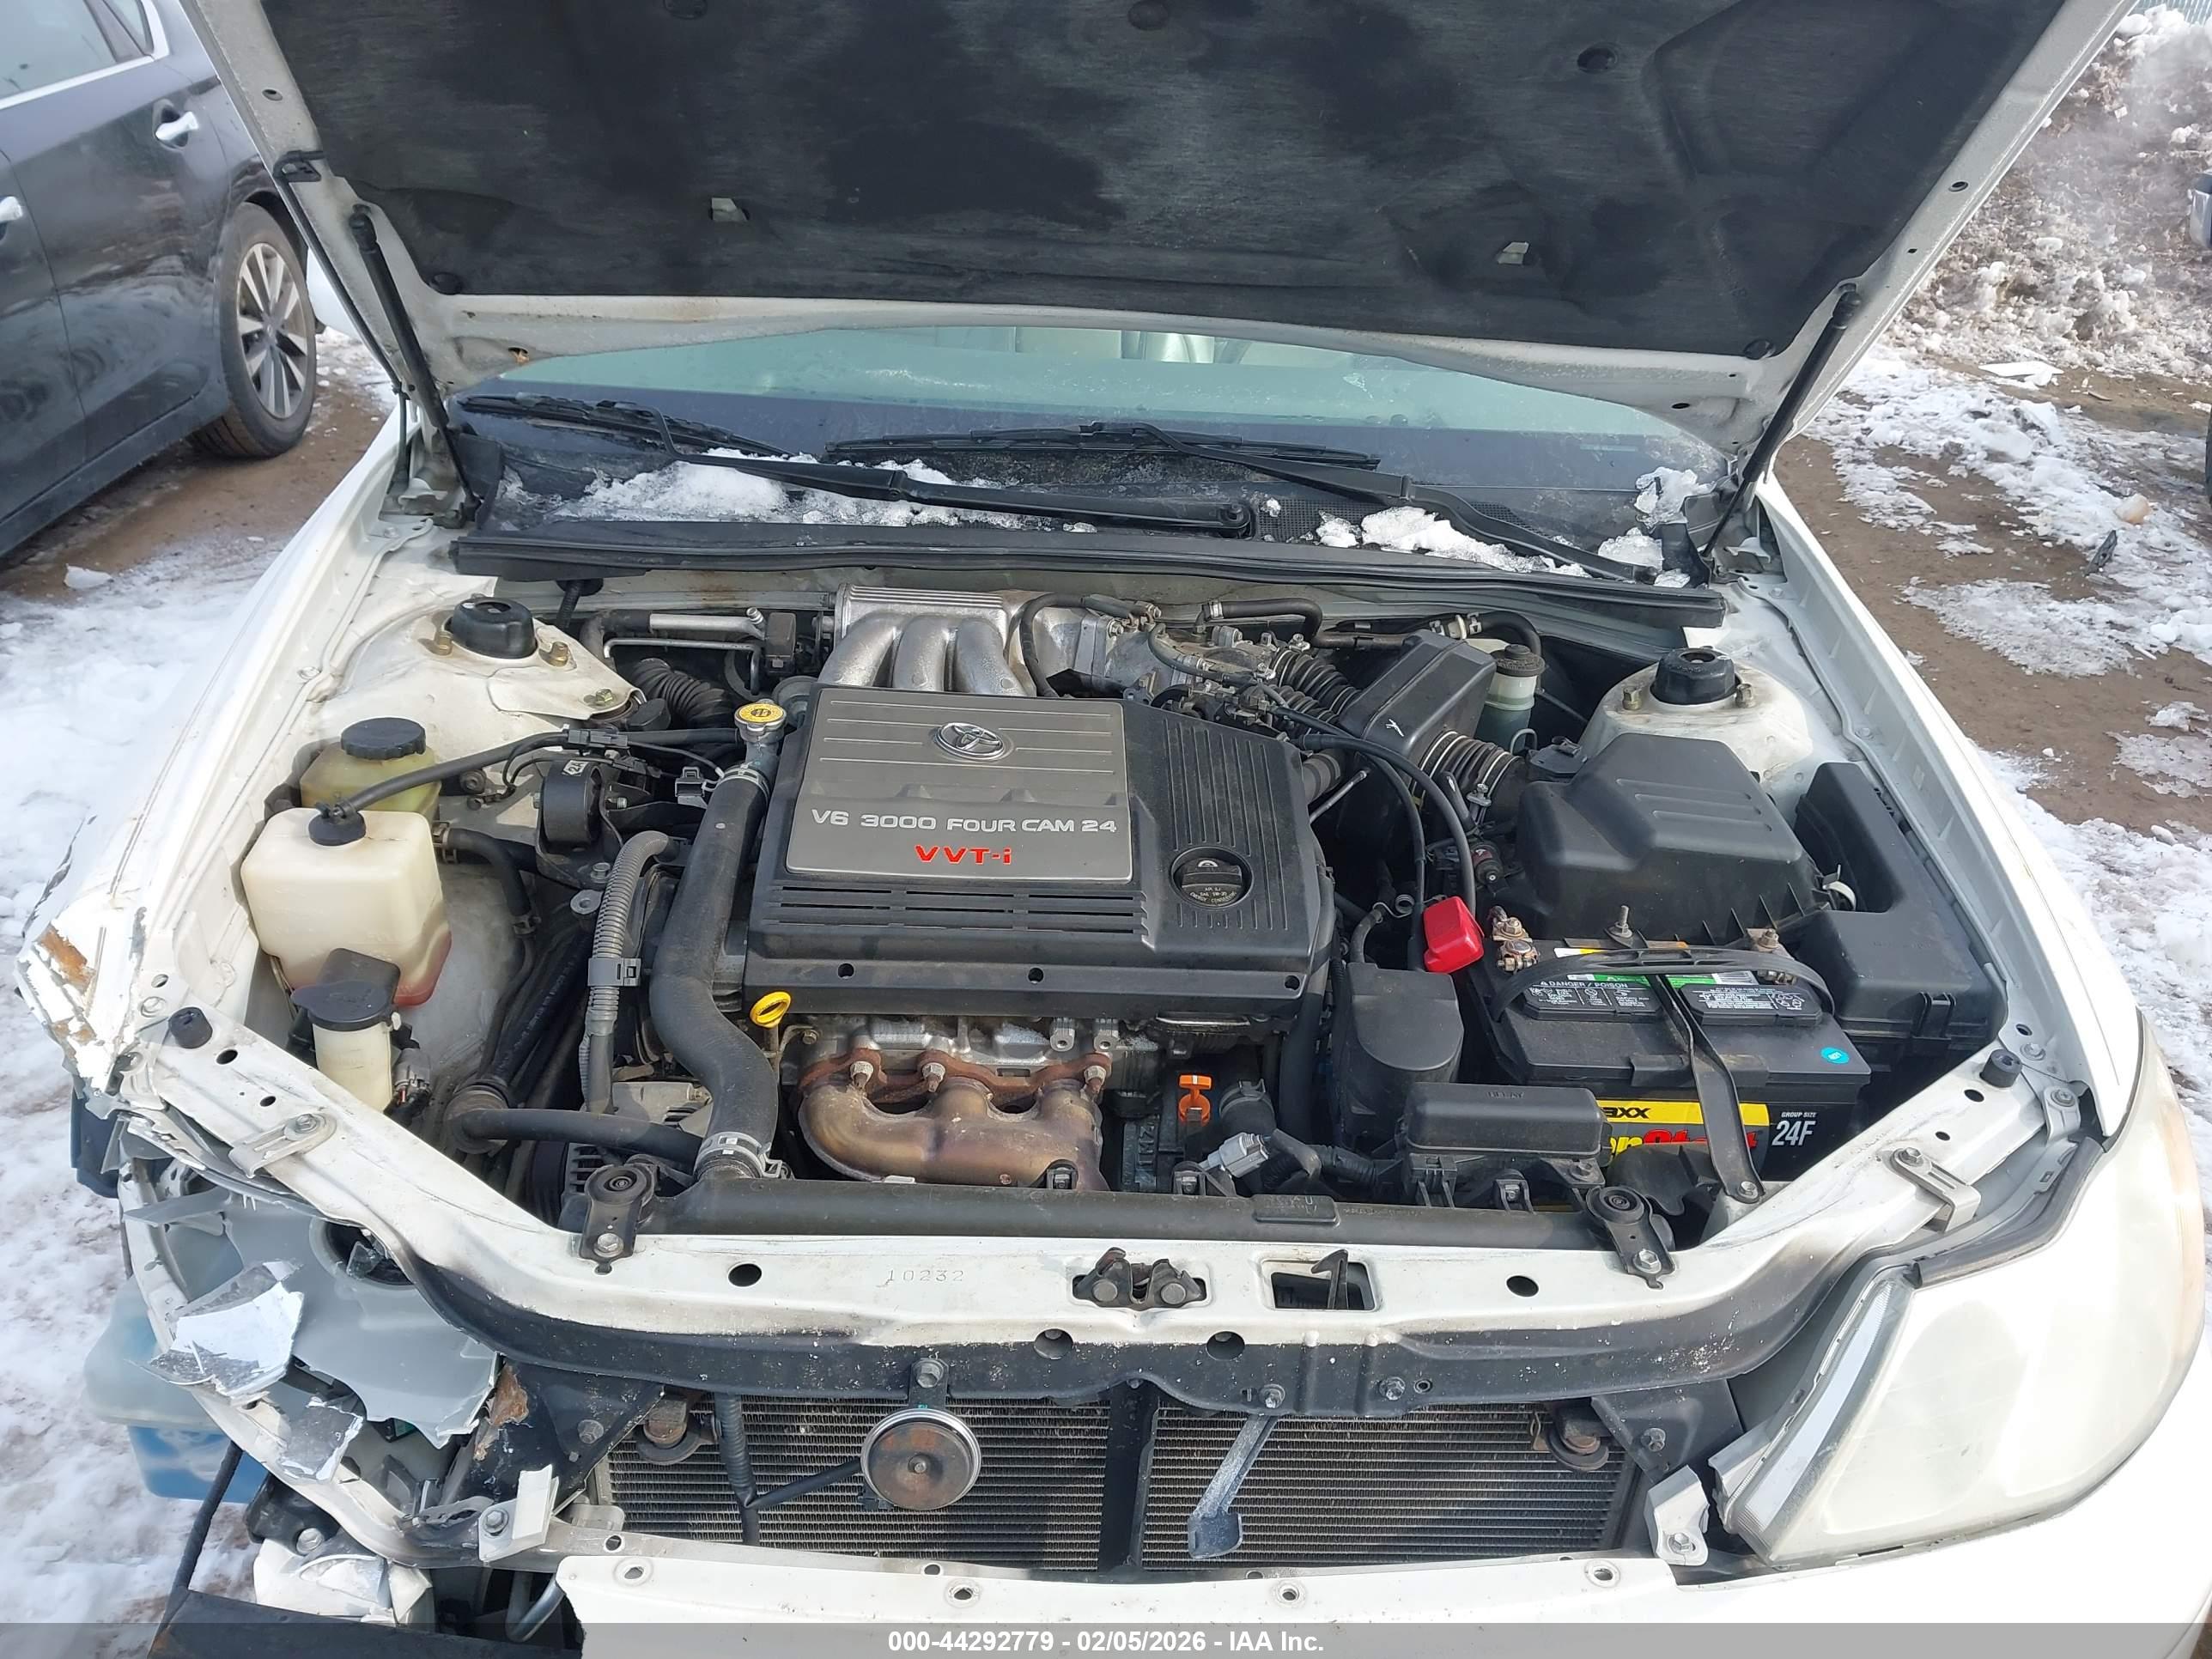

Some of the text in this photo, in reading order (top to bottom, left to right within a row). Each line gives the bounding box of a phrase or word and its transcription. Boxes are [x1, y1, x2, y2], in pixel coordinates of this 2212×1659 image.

[811, 809, 1117, 833] V6 3000 FOUR CAM 24
[915, 844, 1012, 865] VVT-i
[1771, 1120, 1817, 1147] 24F
[887, 1269, 963, 1282] 10232
